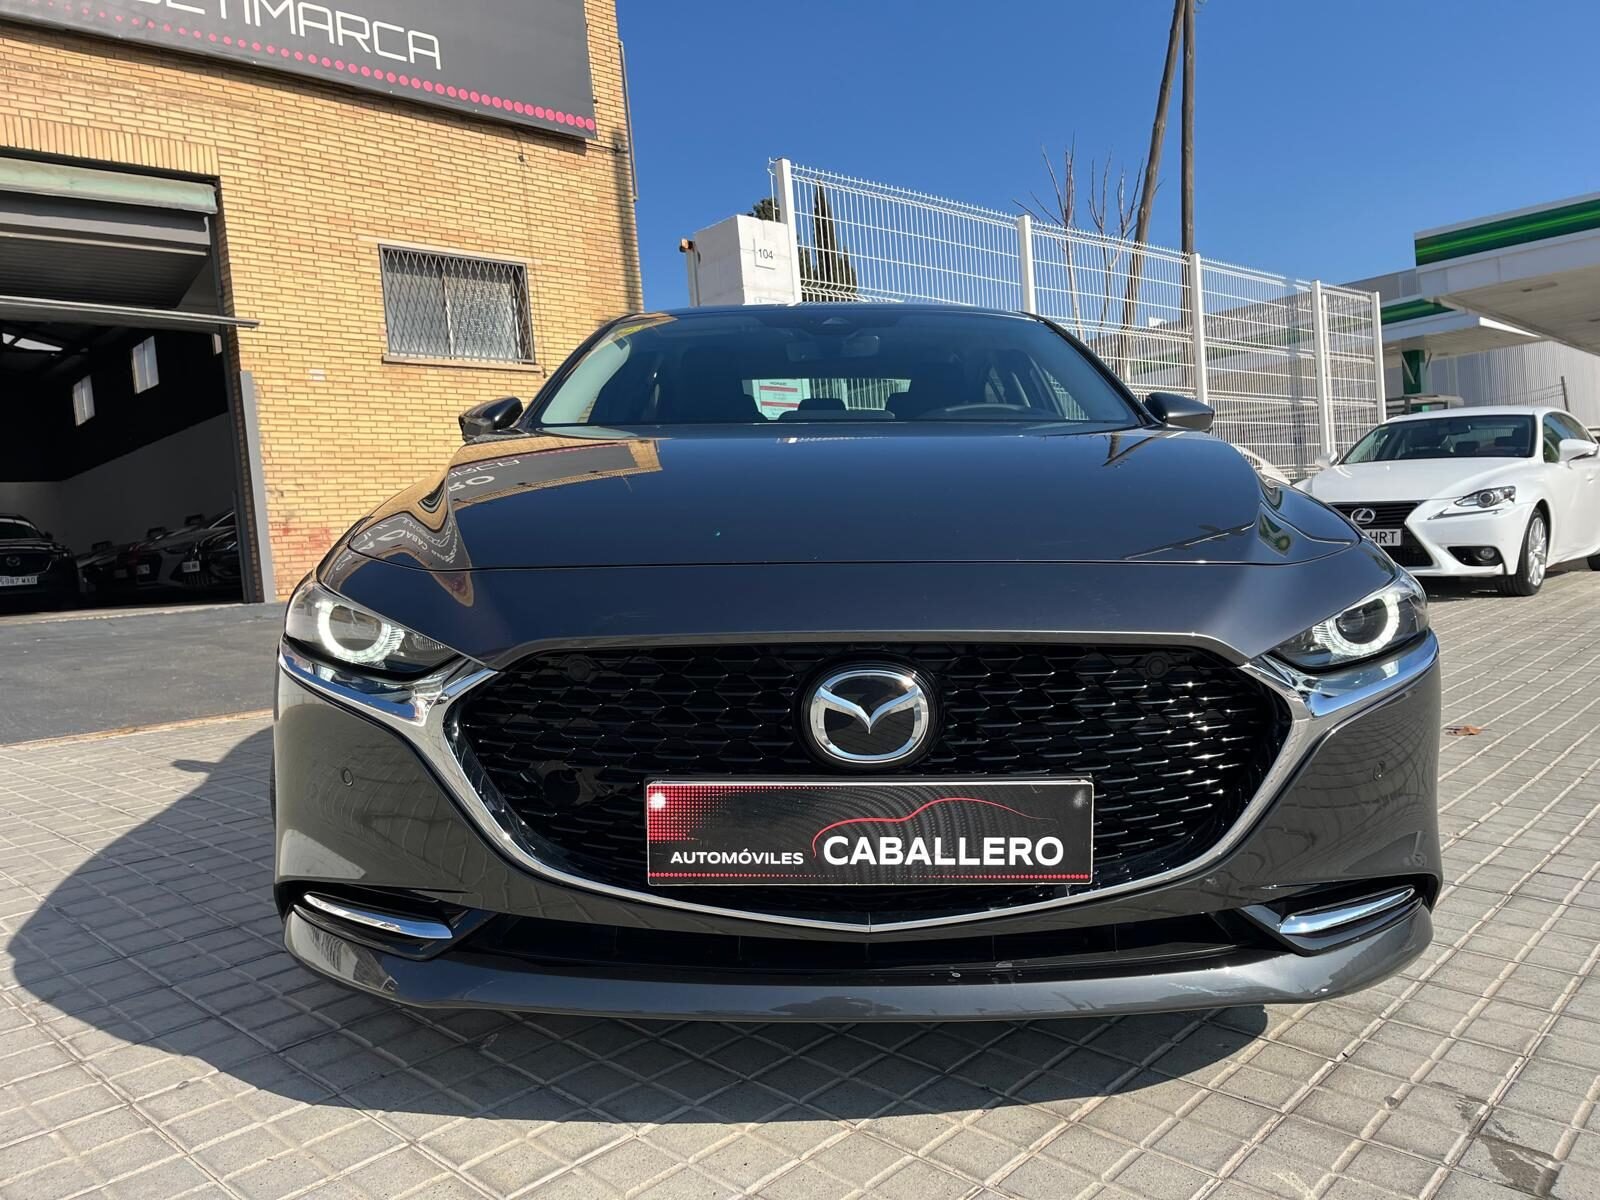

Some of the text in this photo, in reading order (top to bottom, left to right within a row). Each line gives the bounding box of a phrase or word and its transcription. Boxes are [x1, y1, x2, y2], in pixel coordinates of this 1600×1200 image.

[758, 248, 773, 259] 104
[1369, 531, 1398, 544] HRT
[670, 835, 1064, 866] AUTOMÓVILES CABALLERO
